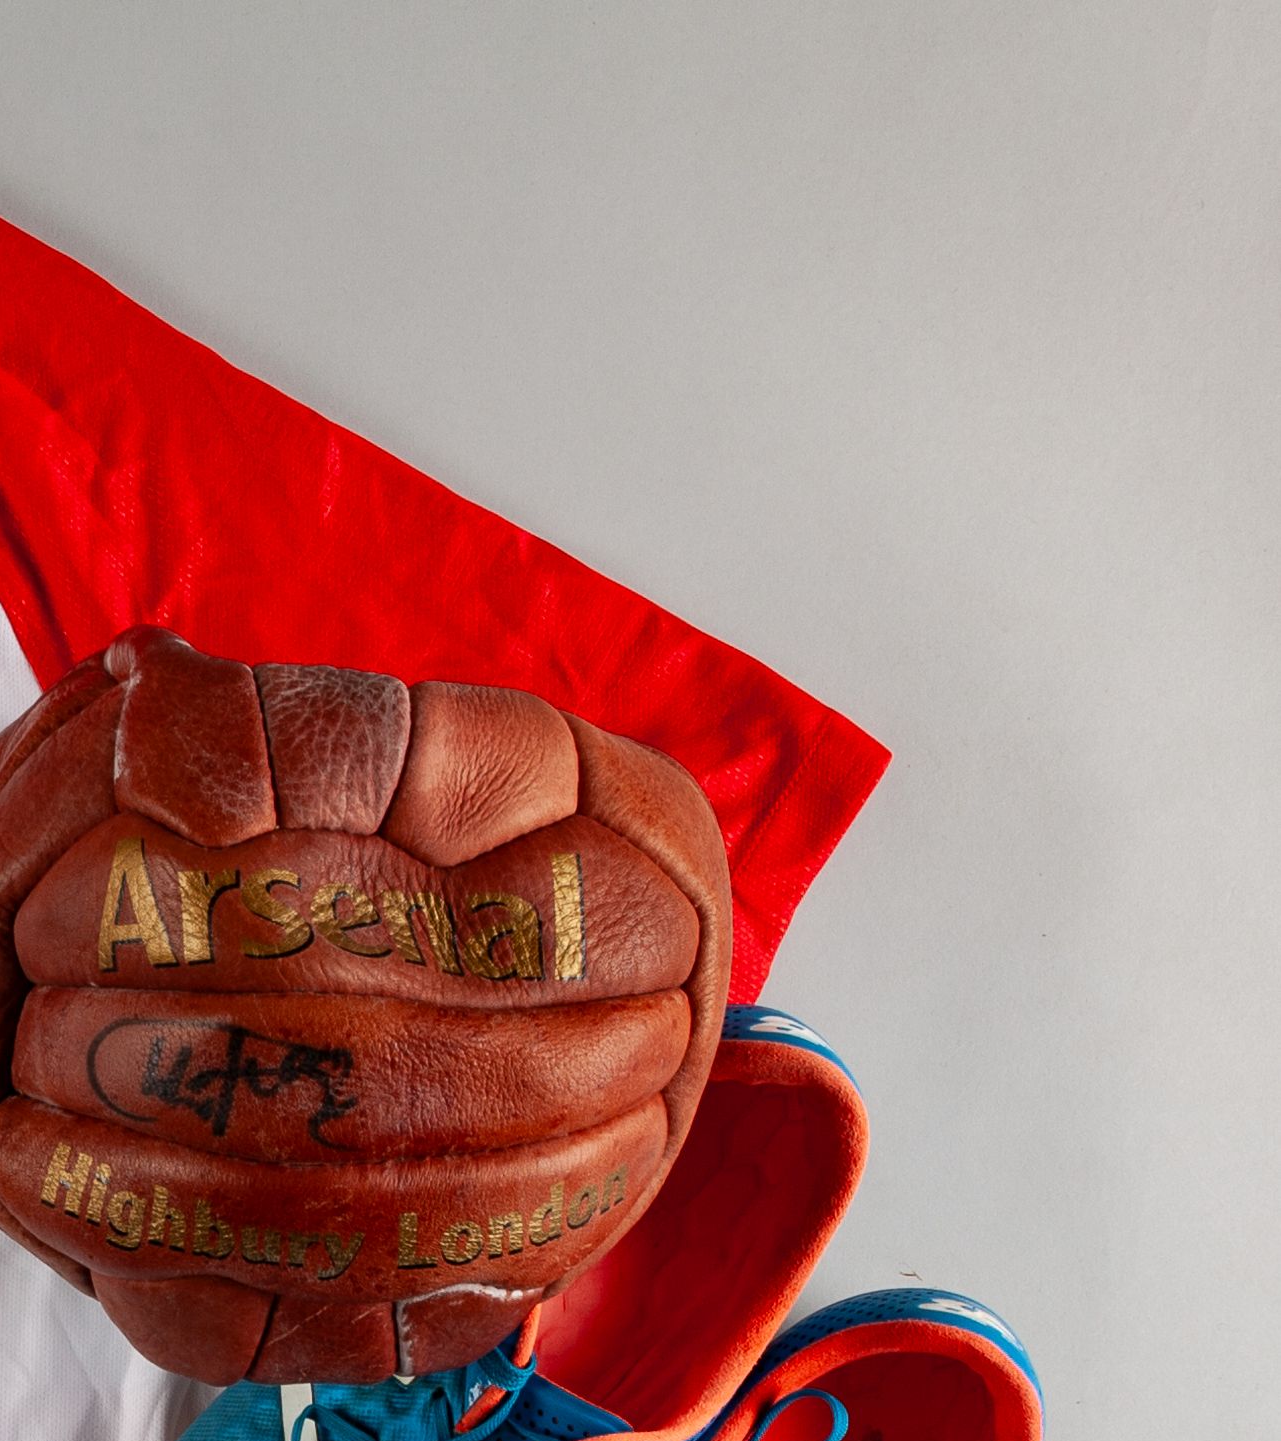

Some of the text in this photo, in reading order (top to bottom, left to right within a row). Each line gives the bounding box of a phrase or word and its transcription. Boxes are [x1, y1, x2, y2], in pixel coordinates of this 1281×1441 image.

[97, 836, 588, 983] Arsenal
[39, 1140, 631, 1280] Highbury London
